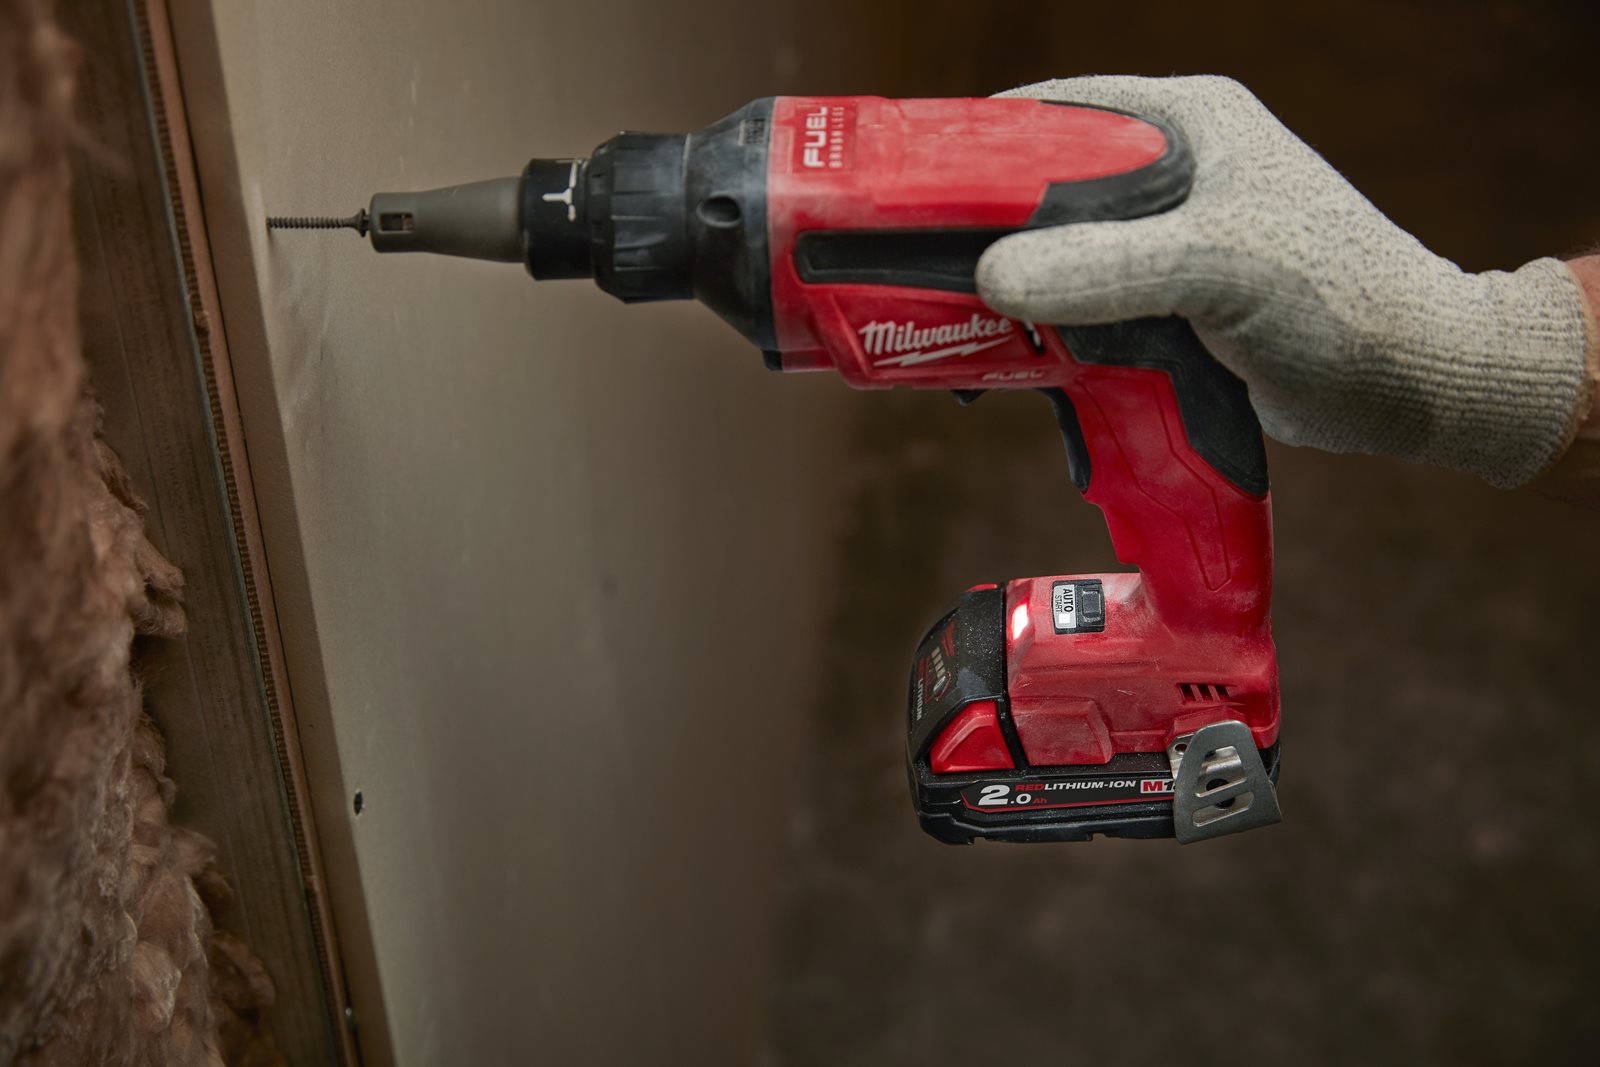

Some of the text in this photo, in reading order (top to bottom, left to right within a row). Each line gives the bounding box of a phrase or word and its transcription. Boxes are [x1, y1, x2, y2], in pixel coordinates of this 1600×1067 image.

[803, 106, 827, 168] FUEL
[859, 313, 1014, 354] Milwaukee
[1055, 594, 1063, 612] START
[1063, 588, 1074, 612] AUTO
[978, 784, 1032, 805] 2.0
[1143, 780, 1176, 791] M1
